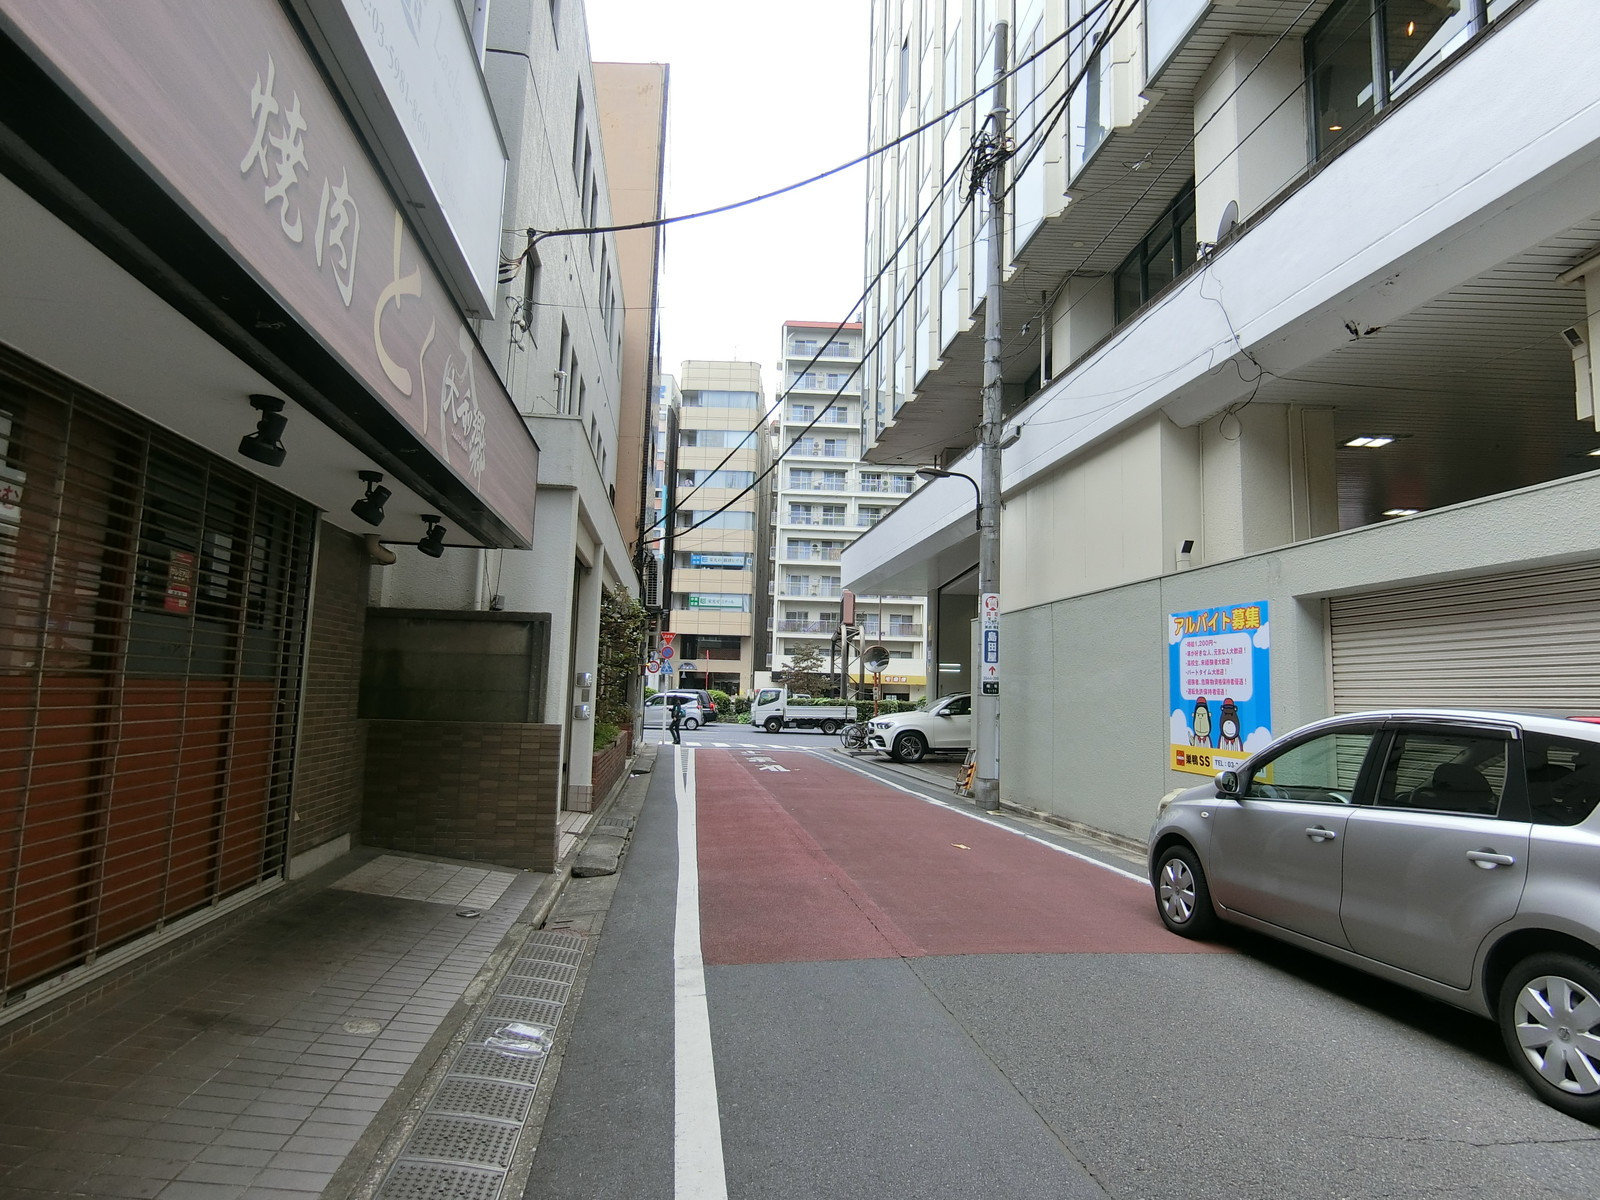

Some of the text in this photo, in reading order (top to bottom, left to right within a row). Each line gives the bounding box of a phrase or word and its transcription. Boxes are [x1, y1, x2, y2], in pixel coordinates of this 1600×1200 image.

[1173, 606, 1261, 636] アルバイト募集
